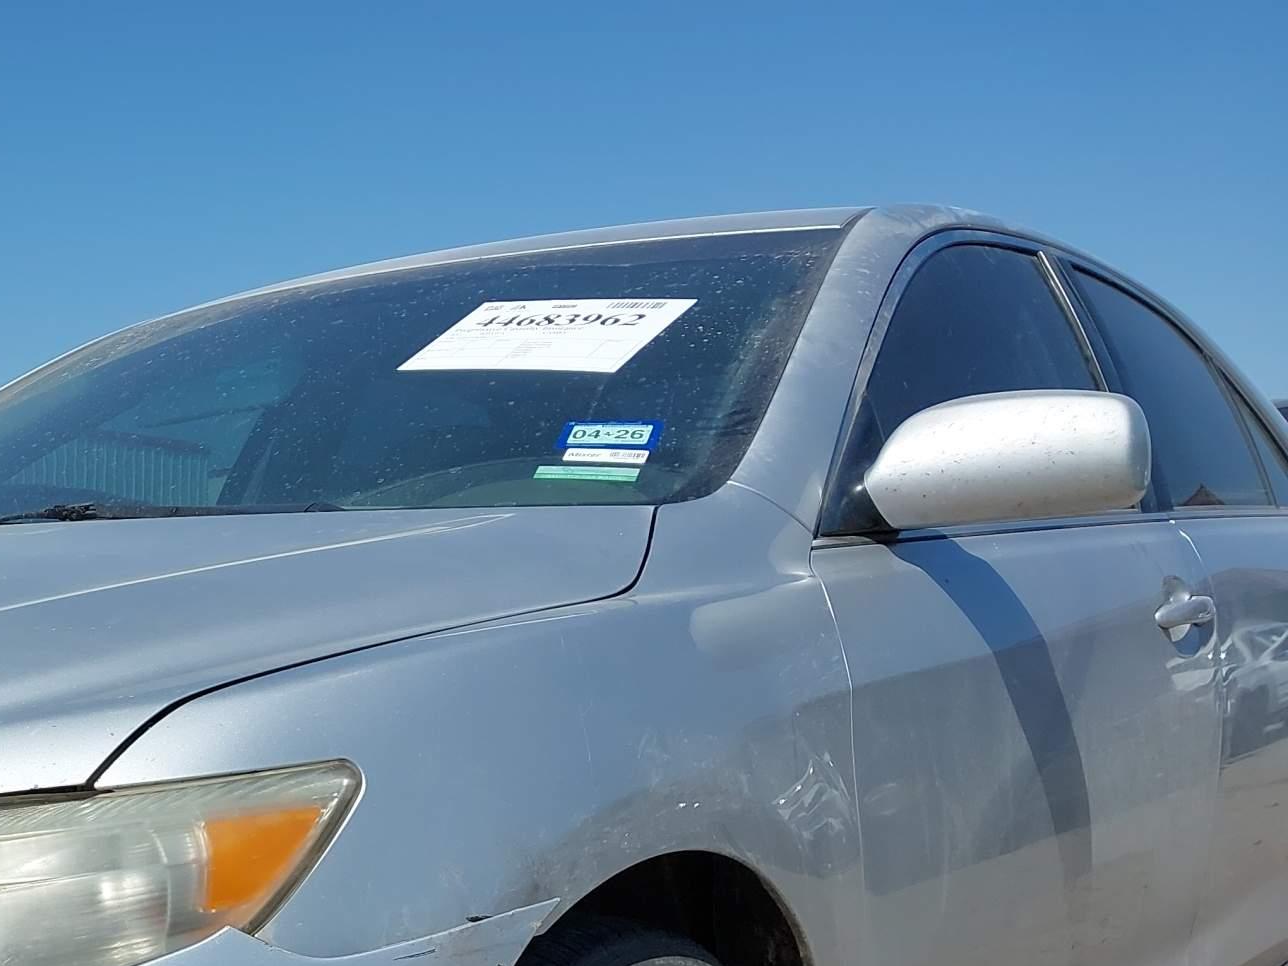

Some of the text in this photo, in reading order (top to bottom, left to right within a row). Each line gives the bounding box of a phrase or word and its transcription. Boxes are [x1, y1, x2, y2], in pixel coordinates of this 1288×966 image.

[476, 313, 646, 326] 44683962
[572, 429, 645, 439] 04 26
